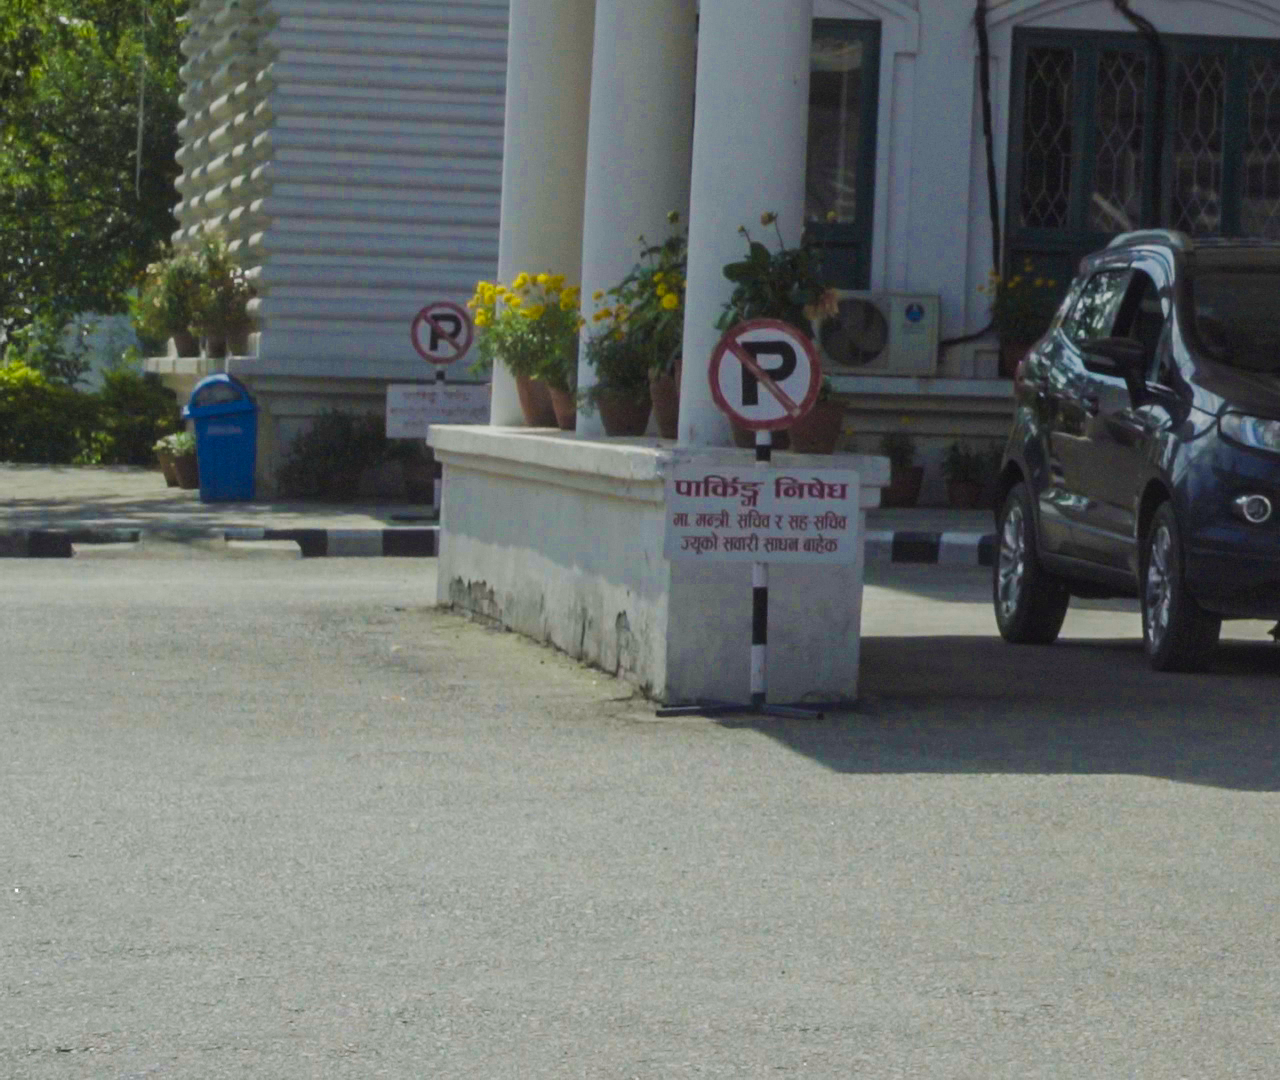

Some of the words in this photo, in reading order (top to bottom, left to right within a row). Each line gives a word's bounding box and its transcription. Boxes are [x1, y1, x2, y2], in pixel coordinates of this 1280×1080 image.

[741, 341, 797, 406] P
[774, 476, 849, 500] निषेध
[737, 509, 770, 529] सचिव
[775, 513, 783, 530] र
[723, 533, 759, 552] सवारी
[764, 536, 799, 553] साधन
[803, 534, 838, 554] बाहेक
